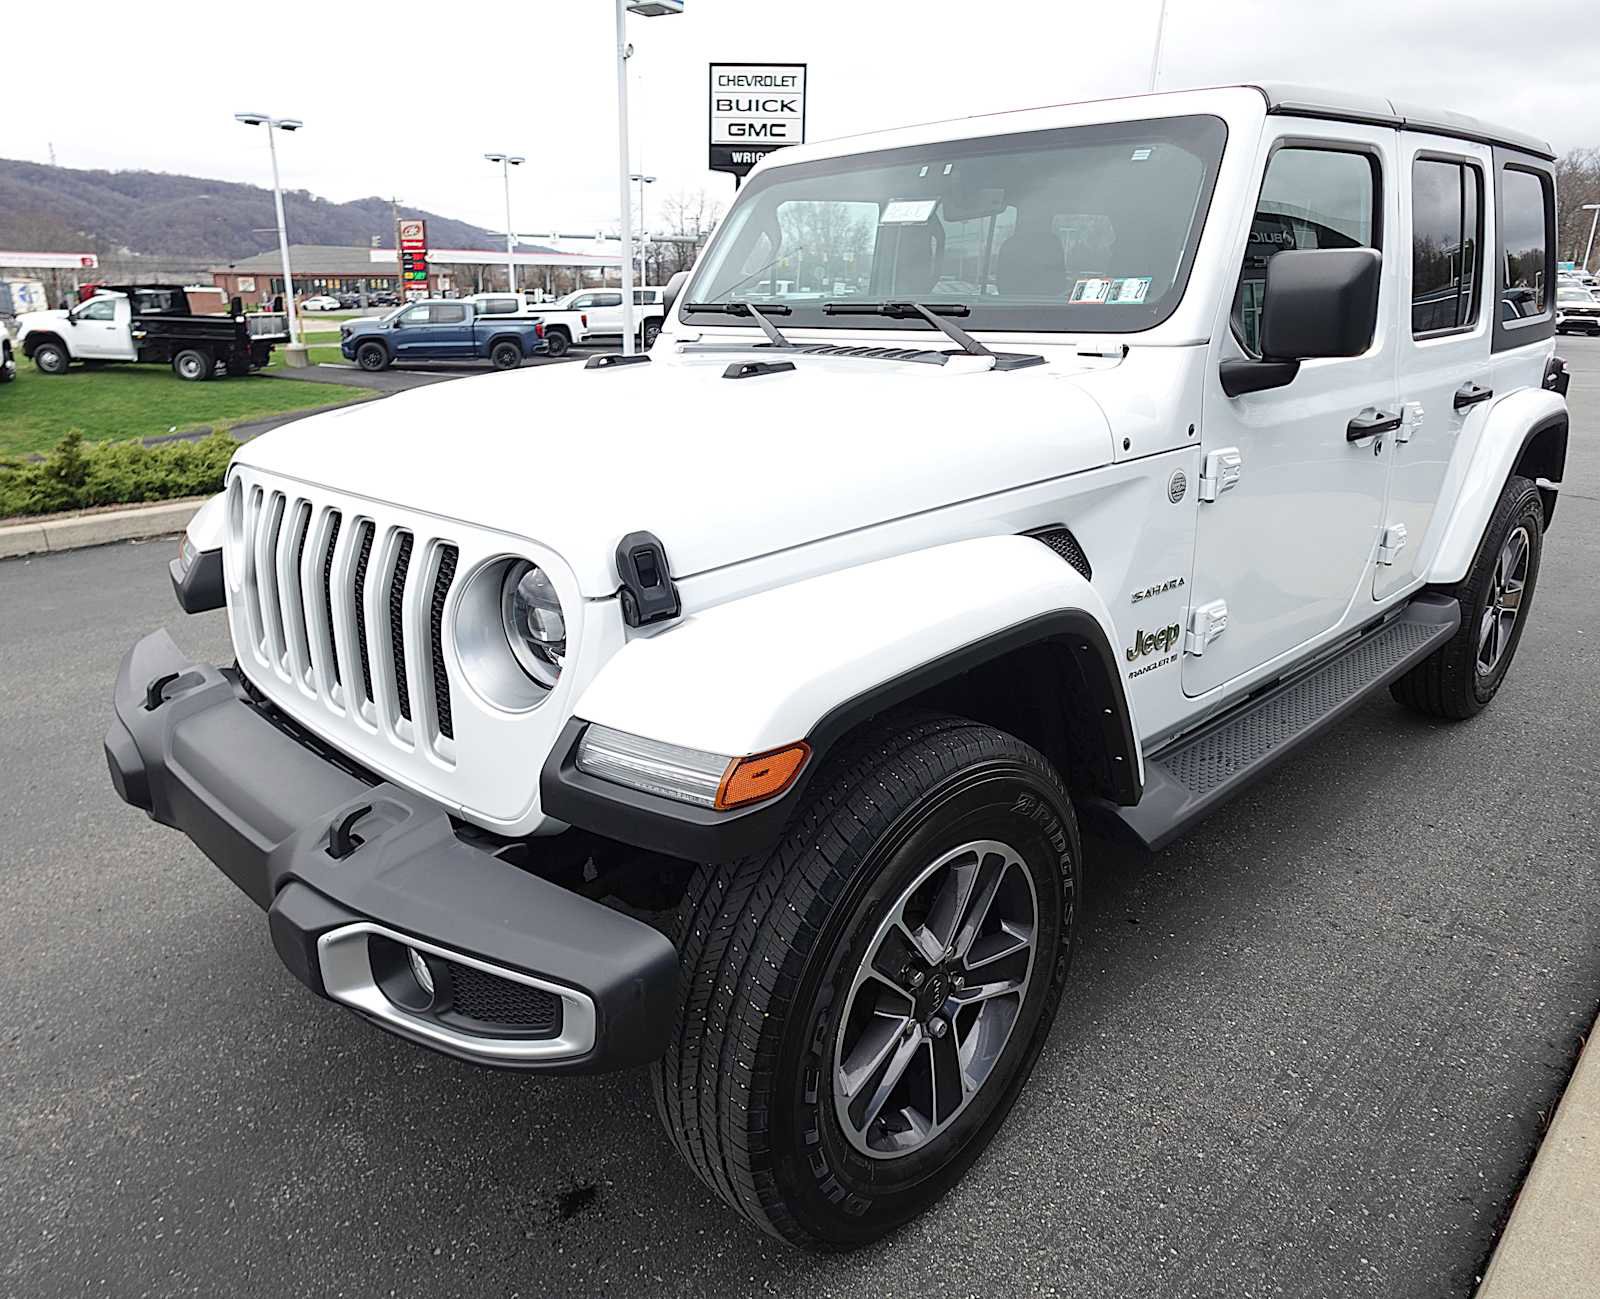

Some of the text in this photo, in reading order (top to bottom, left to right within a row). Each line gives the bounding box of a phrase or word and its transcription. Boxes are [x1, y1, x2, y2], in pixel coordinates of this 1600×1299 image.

[718, 75, 797, 87] CHEVROLET
[716, 99, 798, 112] BUICK
[728, 123, 787, 137] GMC
[731, 151, 766, 164] WRIG
[1131, 577, 1185, 604] SAHARA
[1126, 623, 1180, 662] Jeep
[1009, 791, 1075, 1012] BRIDGESTO
